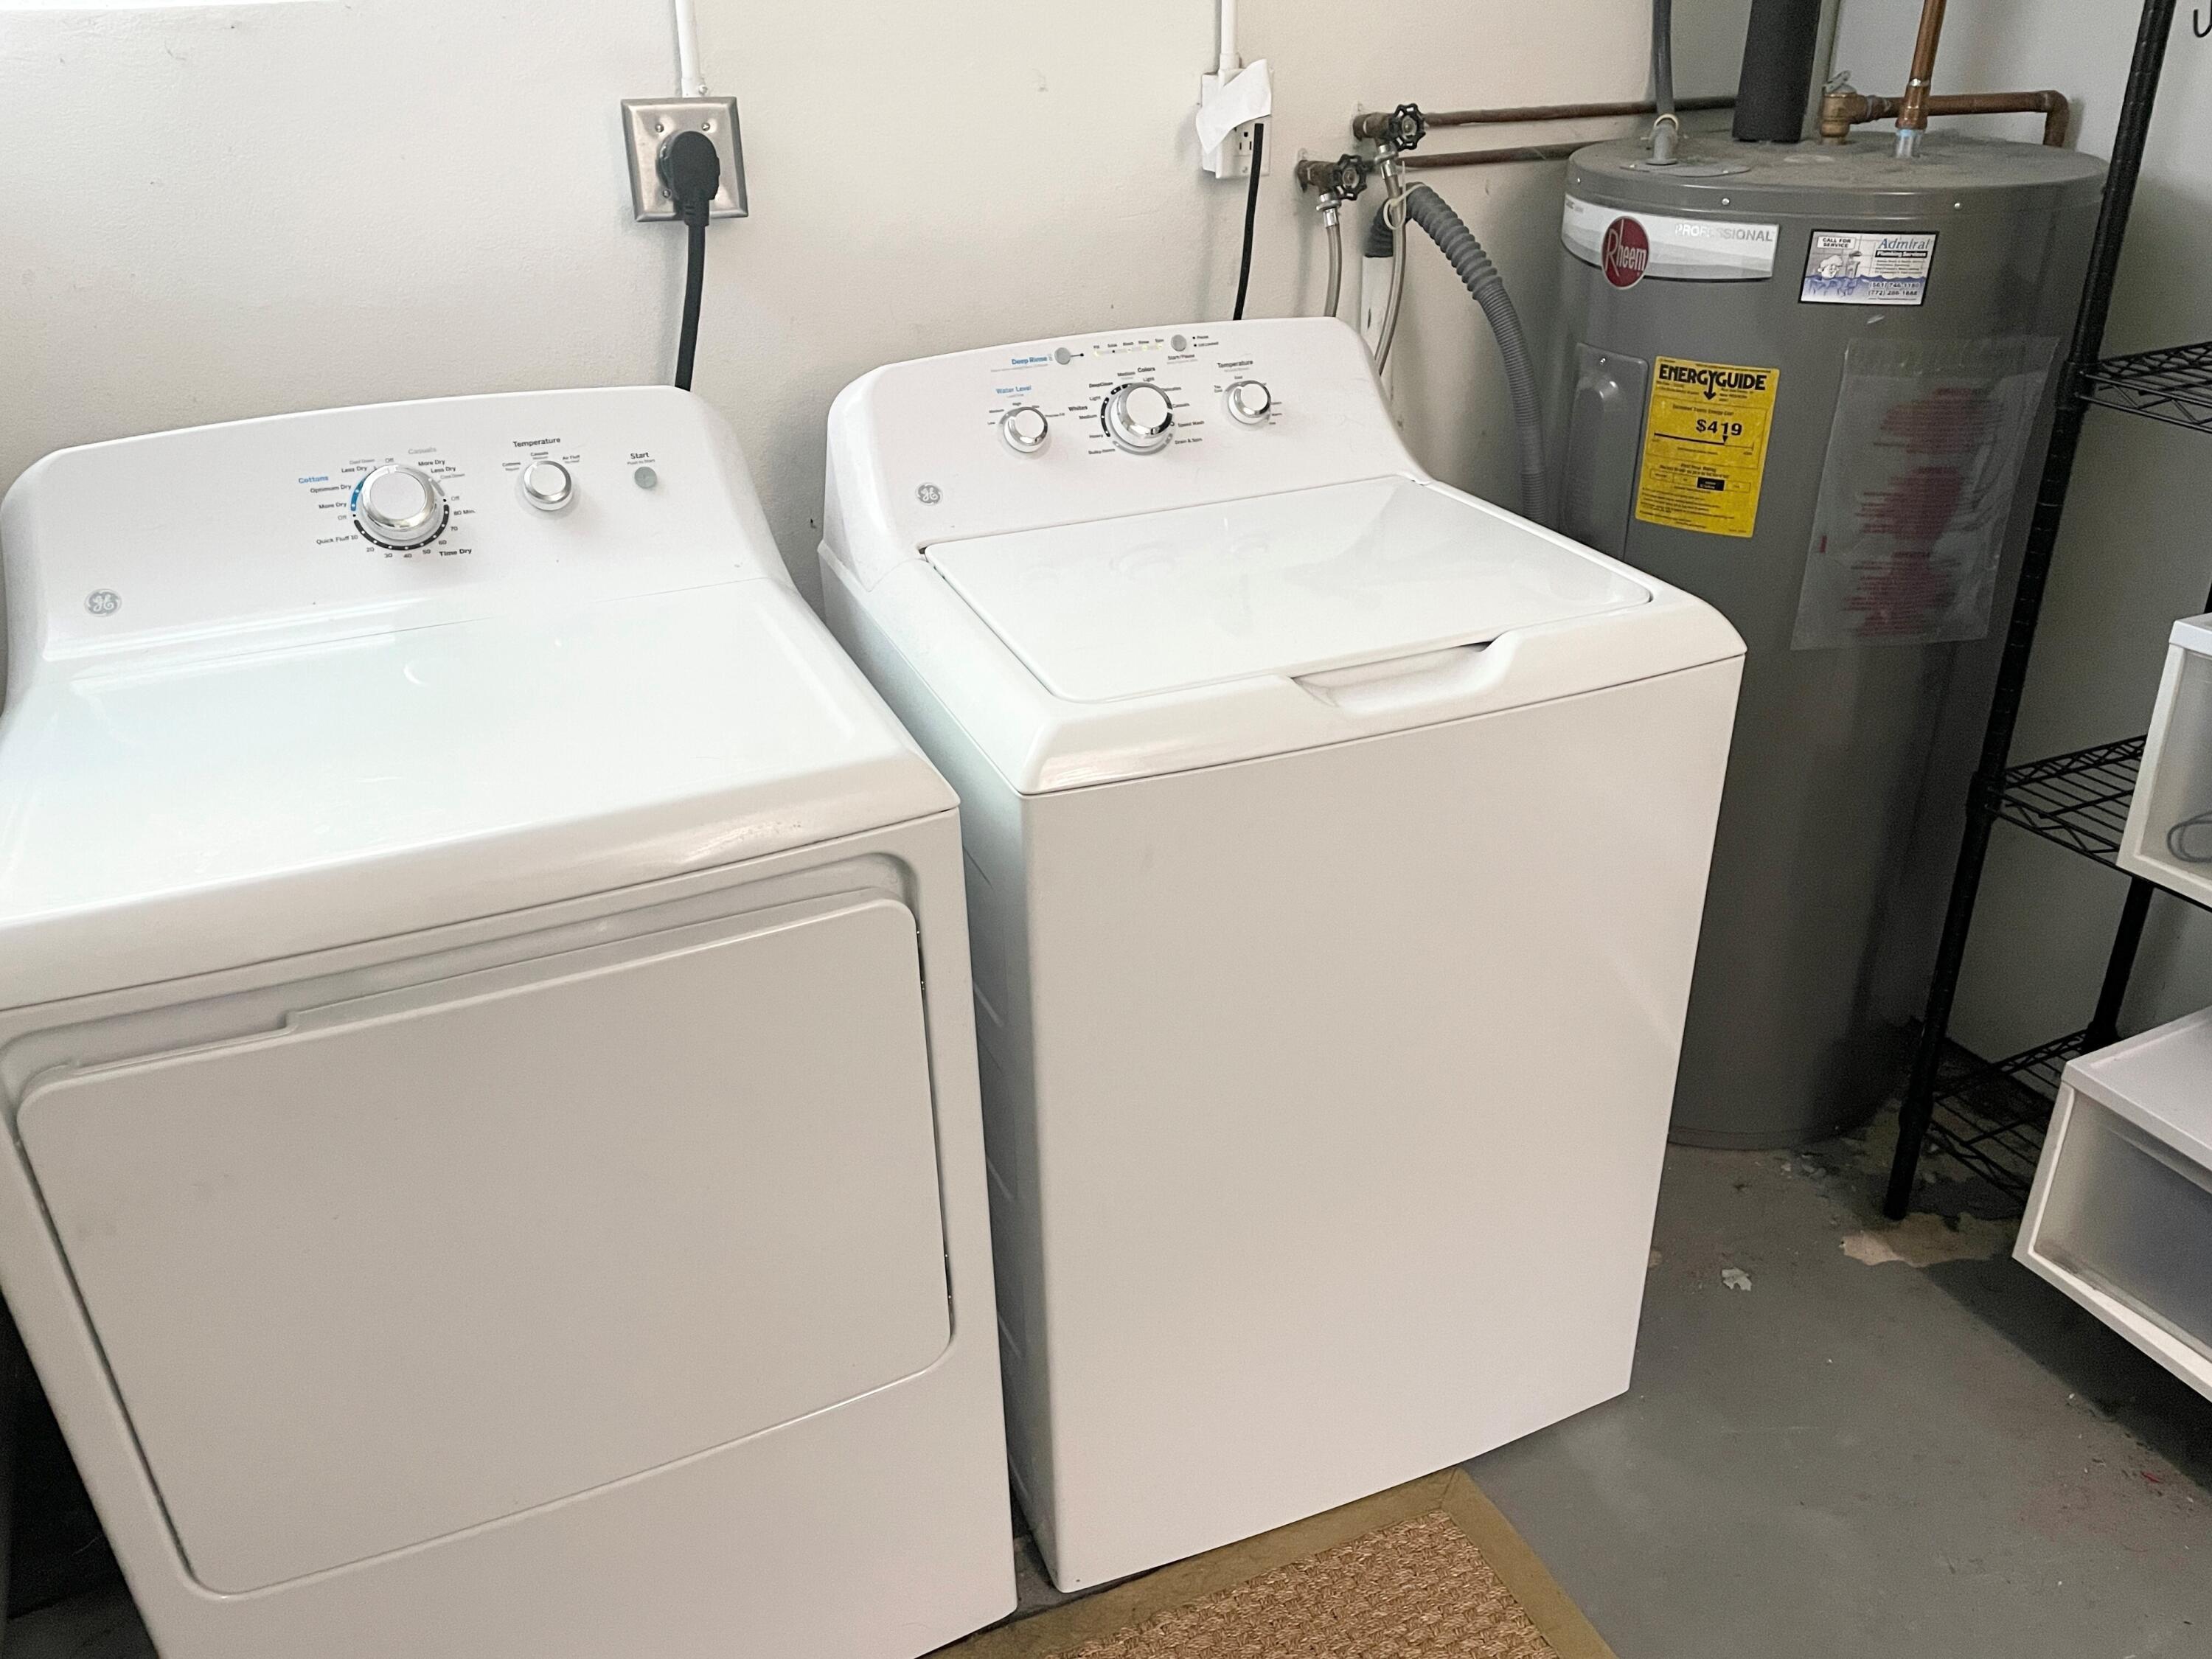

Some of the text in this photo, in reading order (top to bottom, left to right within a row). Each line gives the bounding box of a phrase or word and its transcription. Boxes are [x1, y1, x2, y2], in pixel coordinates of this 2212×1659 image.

[1604, 219, 1646, 276] Rheem
[1877, 238, 1930, 249] Admiral
[1659, 364, 1767, 390] ENERGYGUIDE
[1696, 419, 1742, 435] $419
[513, 437, 560, 447] Temperature
[298, 476, 329, 484] Cottons
[917, 484, 942, 505] GE
